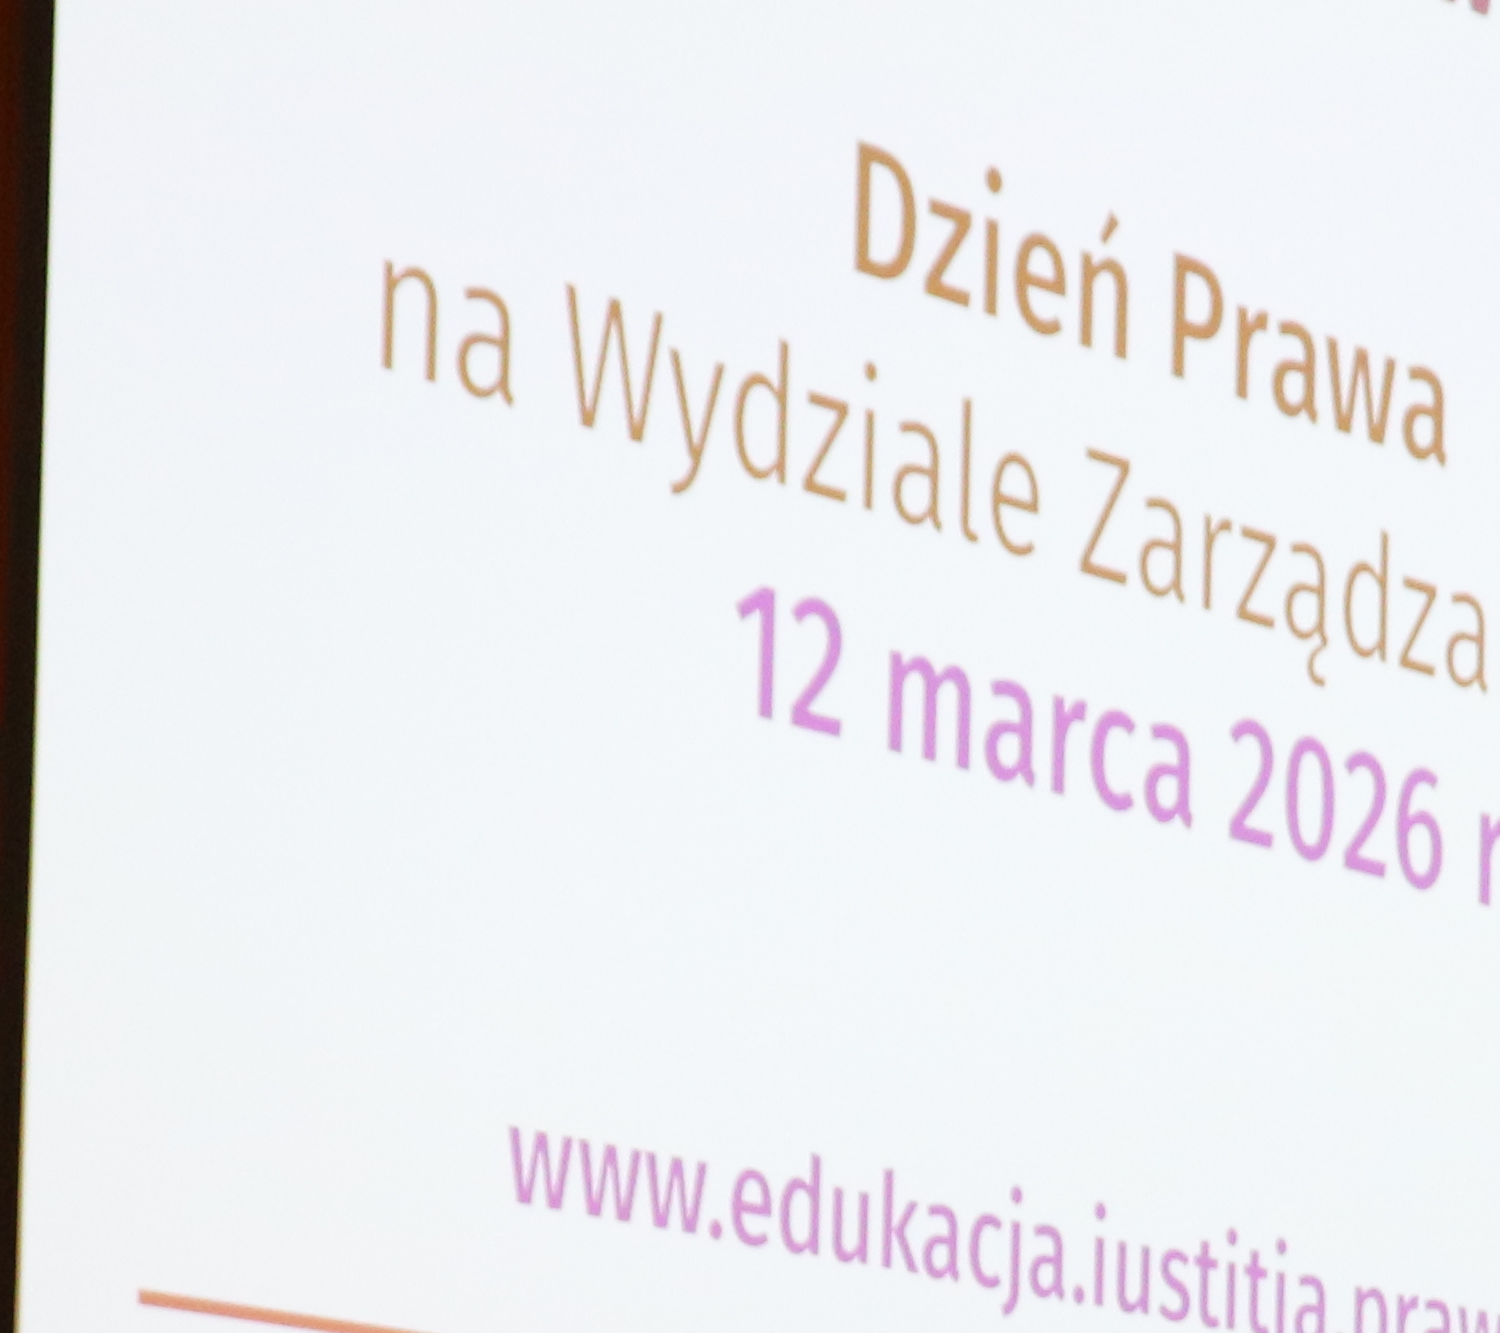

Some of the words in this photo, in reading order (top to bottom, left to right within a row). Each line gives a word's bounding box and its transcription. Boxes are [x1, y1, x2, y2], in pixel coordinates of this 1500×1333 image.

[382, 260, 515, 406] na
[566, 284, 1040, 557] Wydziale
[854, 141, 1129, 360] Dzień
[1171, 253, 1447, 467] Prawa
[736, 586, 843, 738] 12
[887, 650, 1193, 829] marca
[1228, 718, 1444, 891] 2026
